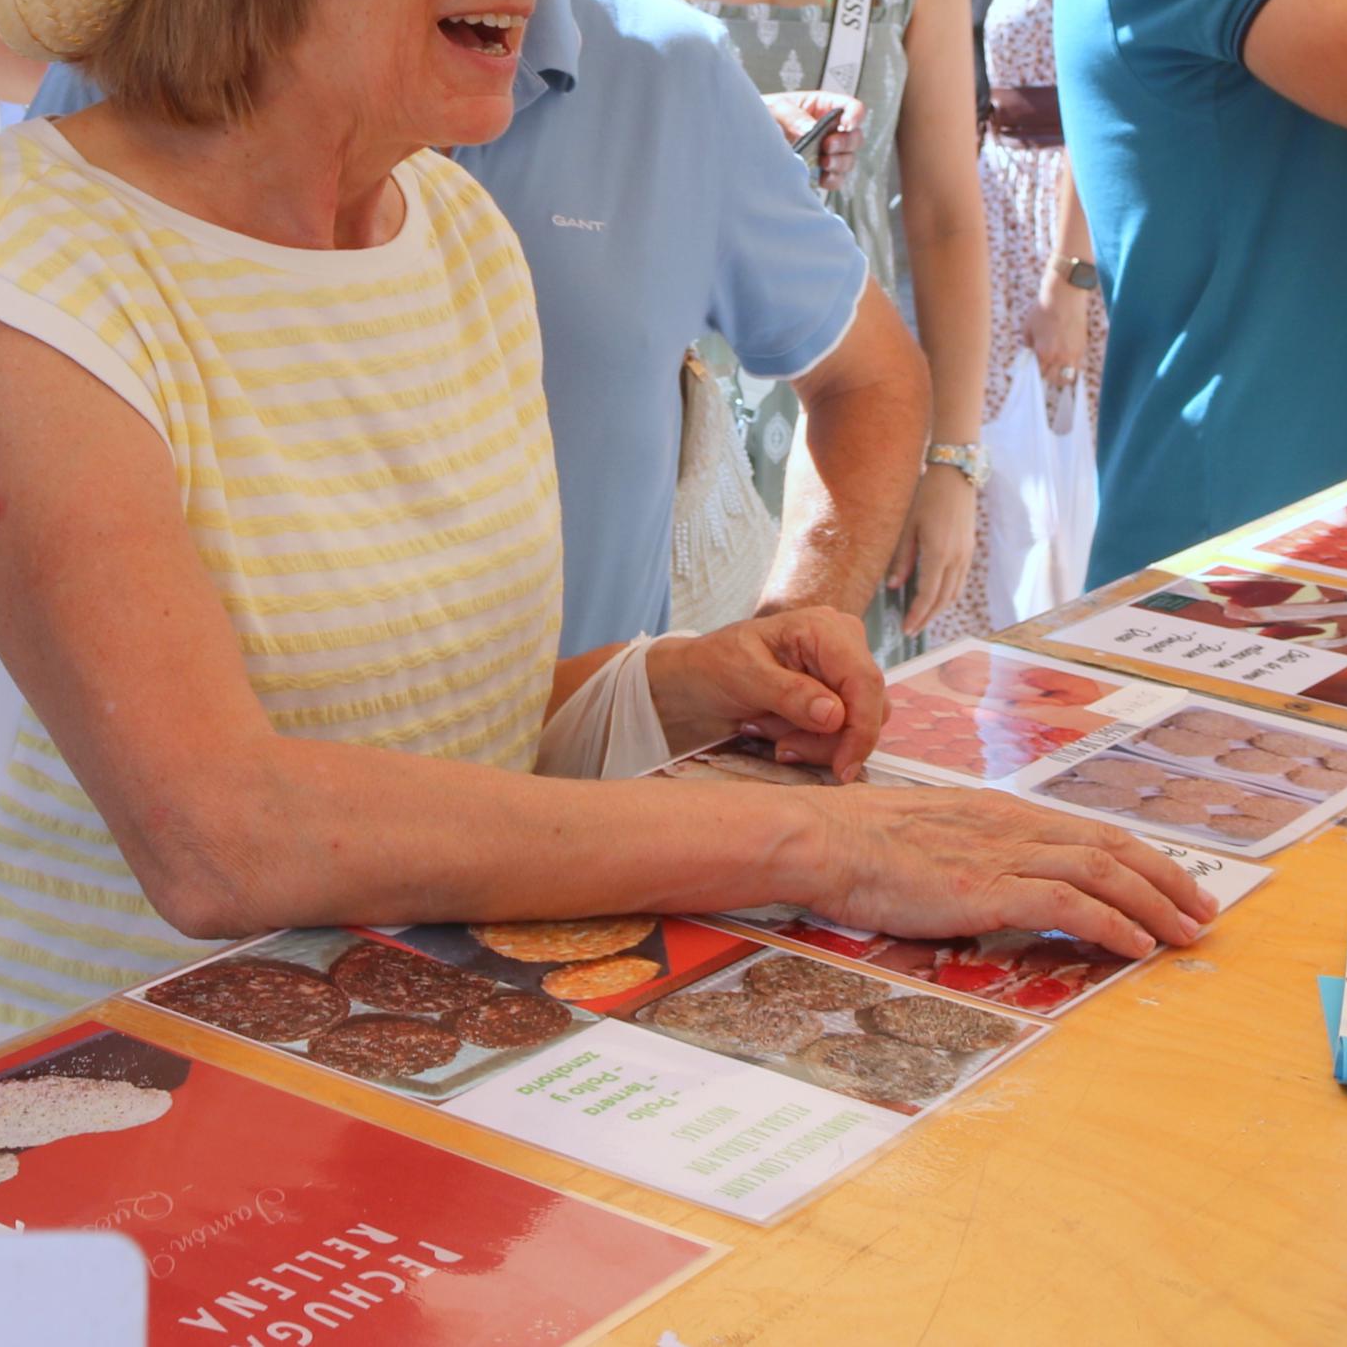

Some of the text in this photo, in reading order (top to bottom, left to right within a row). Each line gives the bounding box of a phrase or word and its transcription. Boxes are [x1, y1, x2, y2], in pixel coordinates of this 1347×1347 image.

[552, 214, 605, 232] GANT
[516, 1051, 601, 1095] zanahoria
[568, 1071, 620, 1096] Pollo
[582, 1082, 656, 1116] Ternera
[627, 1096, 680, 1121] Pollo
[178, 1222, 399, 1333] RELLENA
